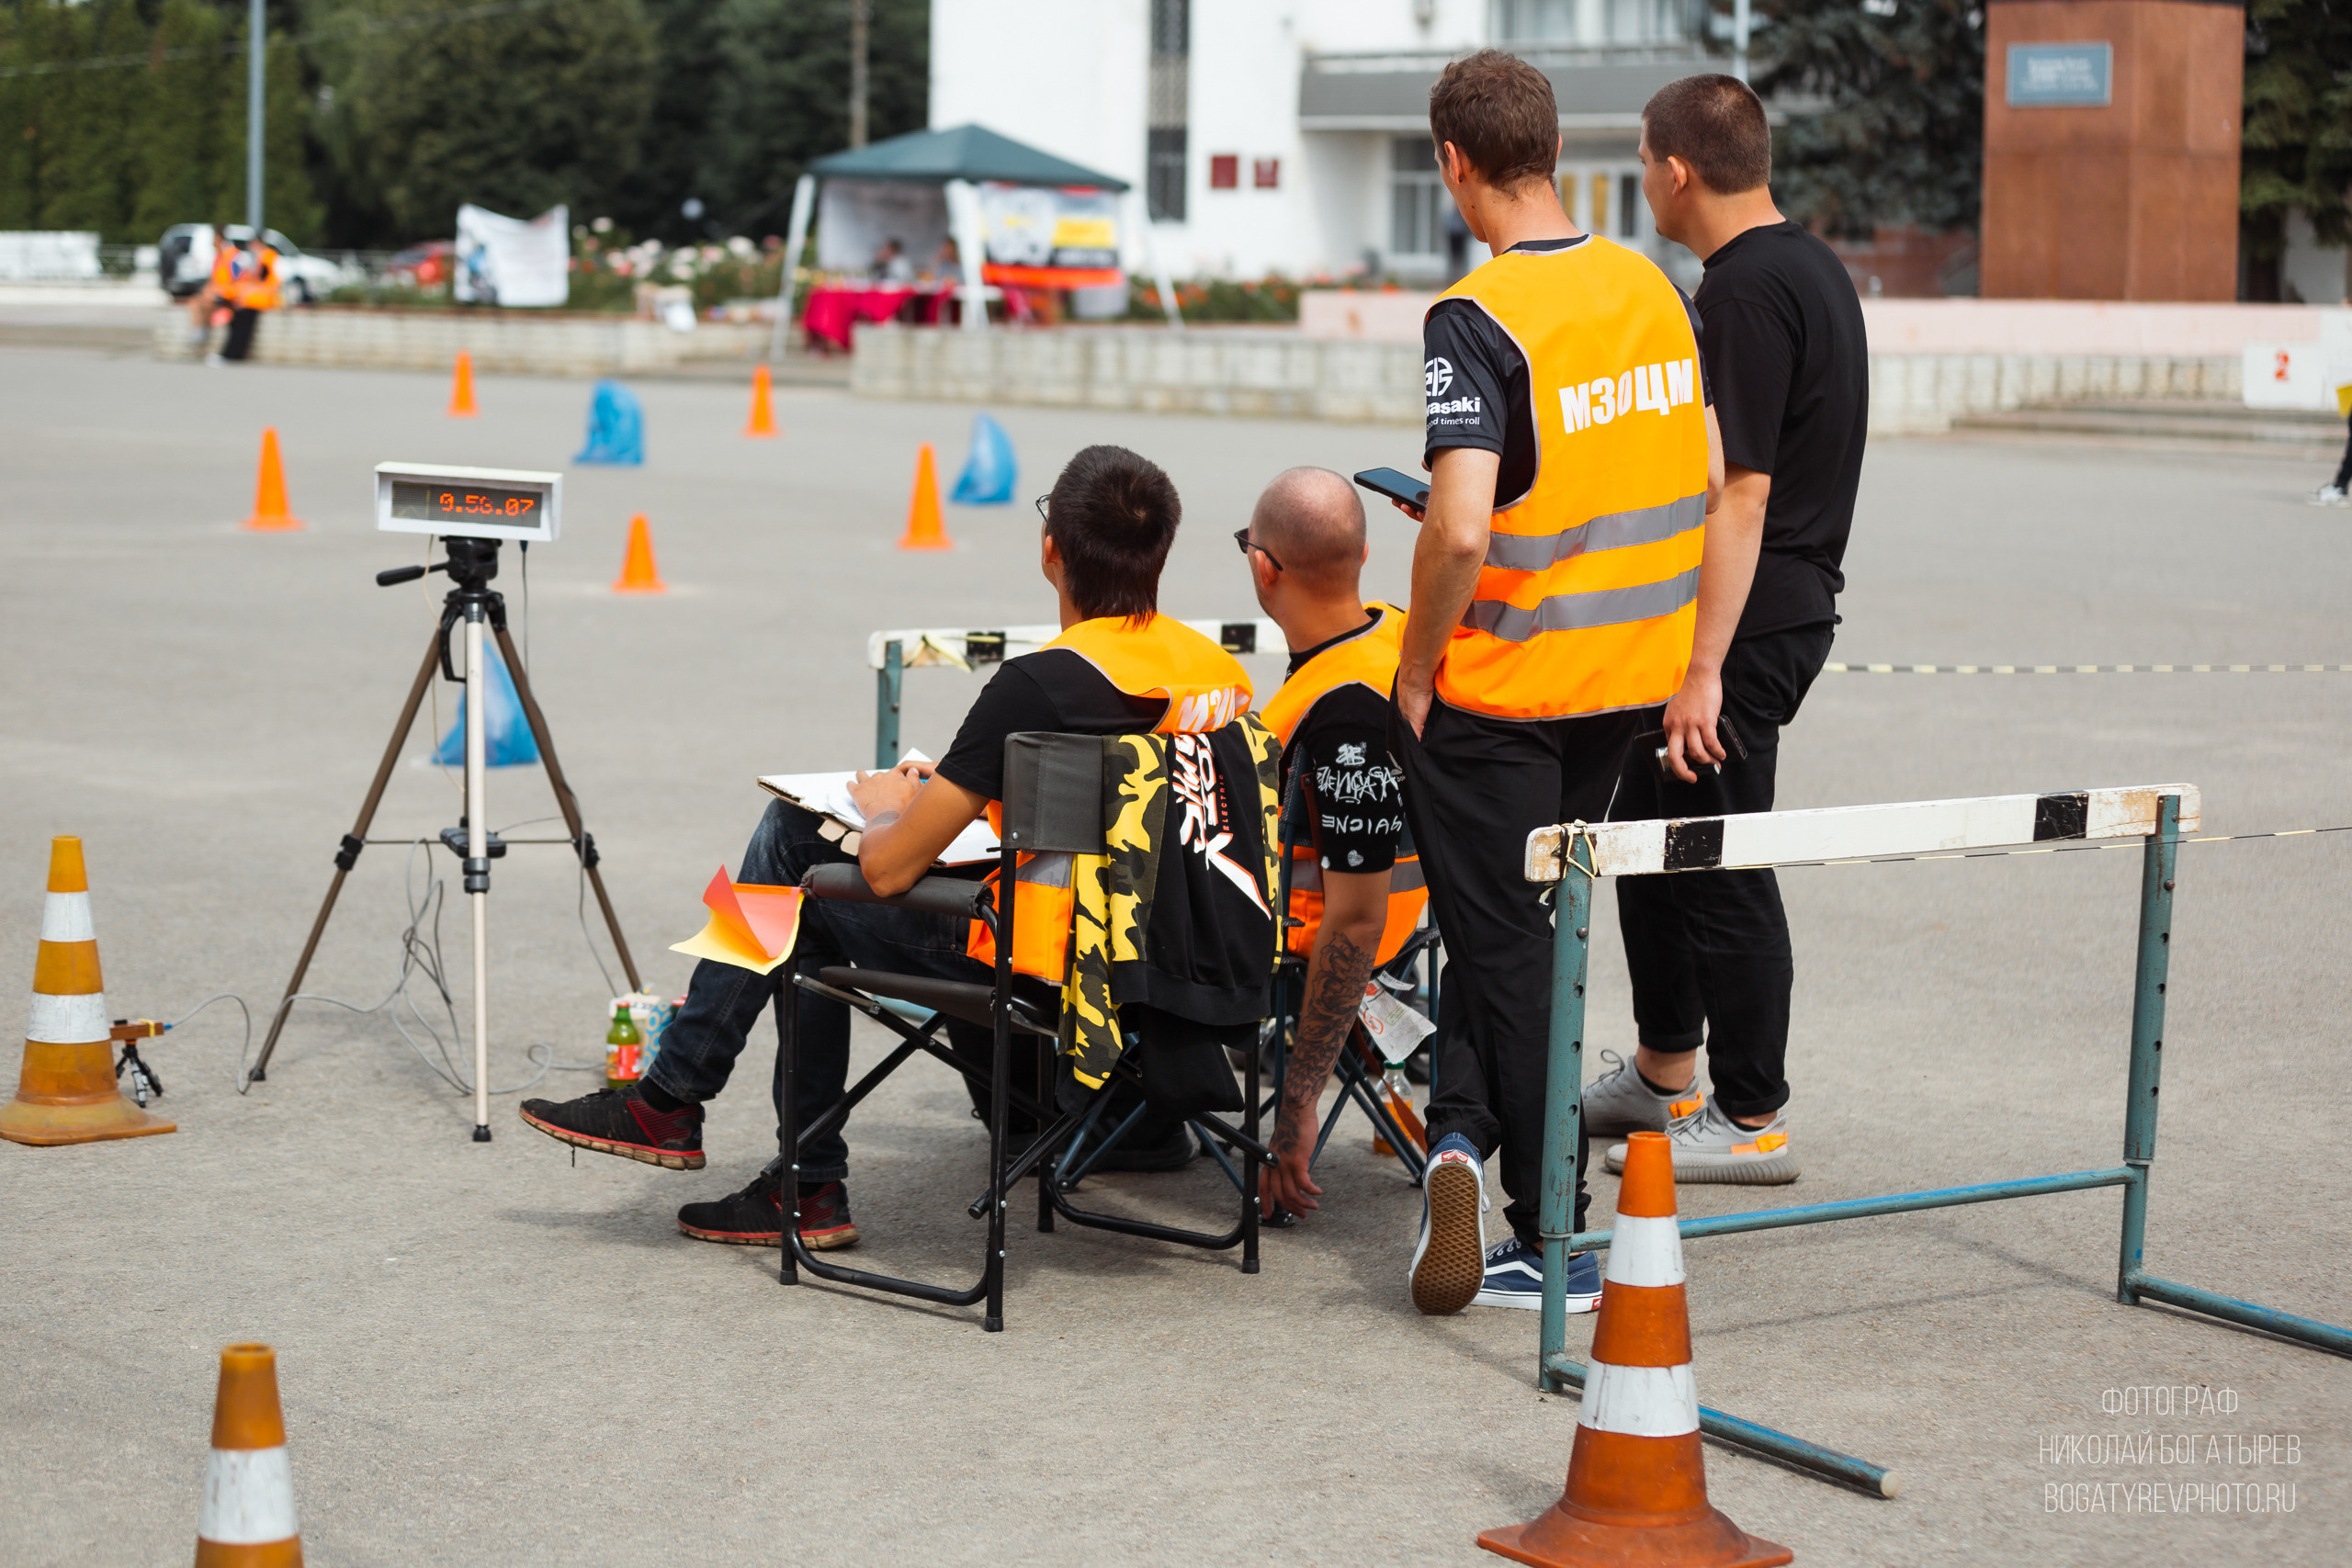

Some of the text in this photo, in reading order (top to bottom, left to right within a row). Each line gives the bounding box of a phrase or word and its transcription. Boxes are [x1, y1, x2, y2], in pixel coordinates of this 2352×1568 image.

[2275, 351, 2290, 381] 2
[1427, 396, 1481, 416] asaki
[1441, 417, 1464, 425] times
[1464, 416, 1480, 425] roll
[1218, 773, 1230, 831] ELECTRIC
